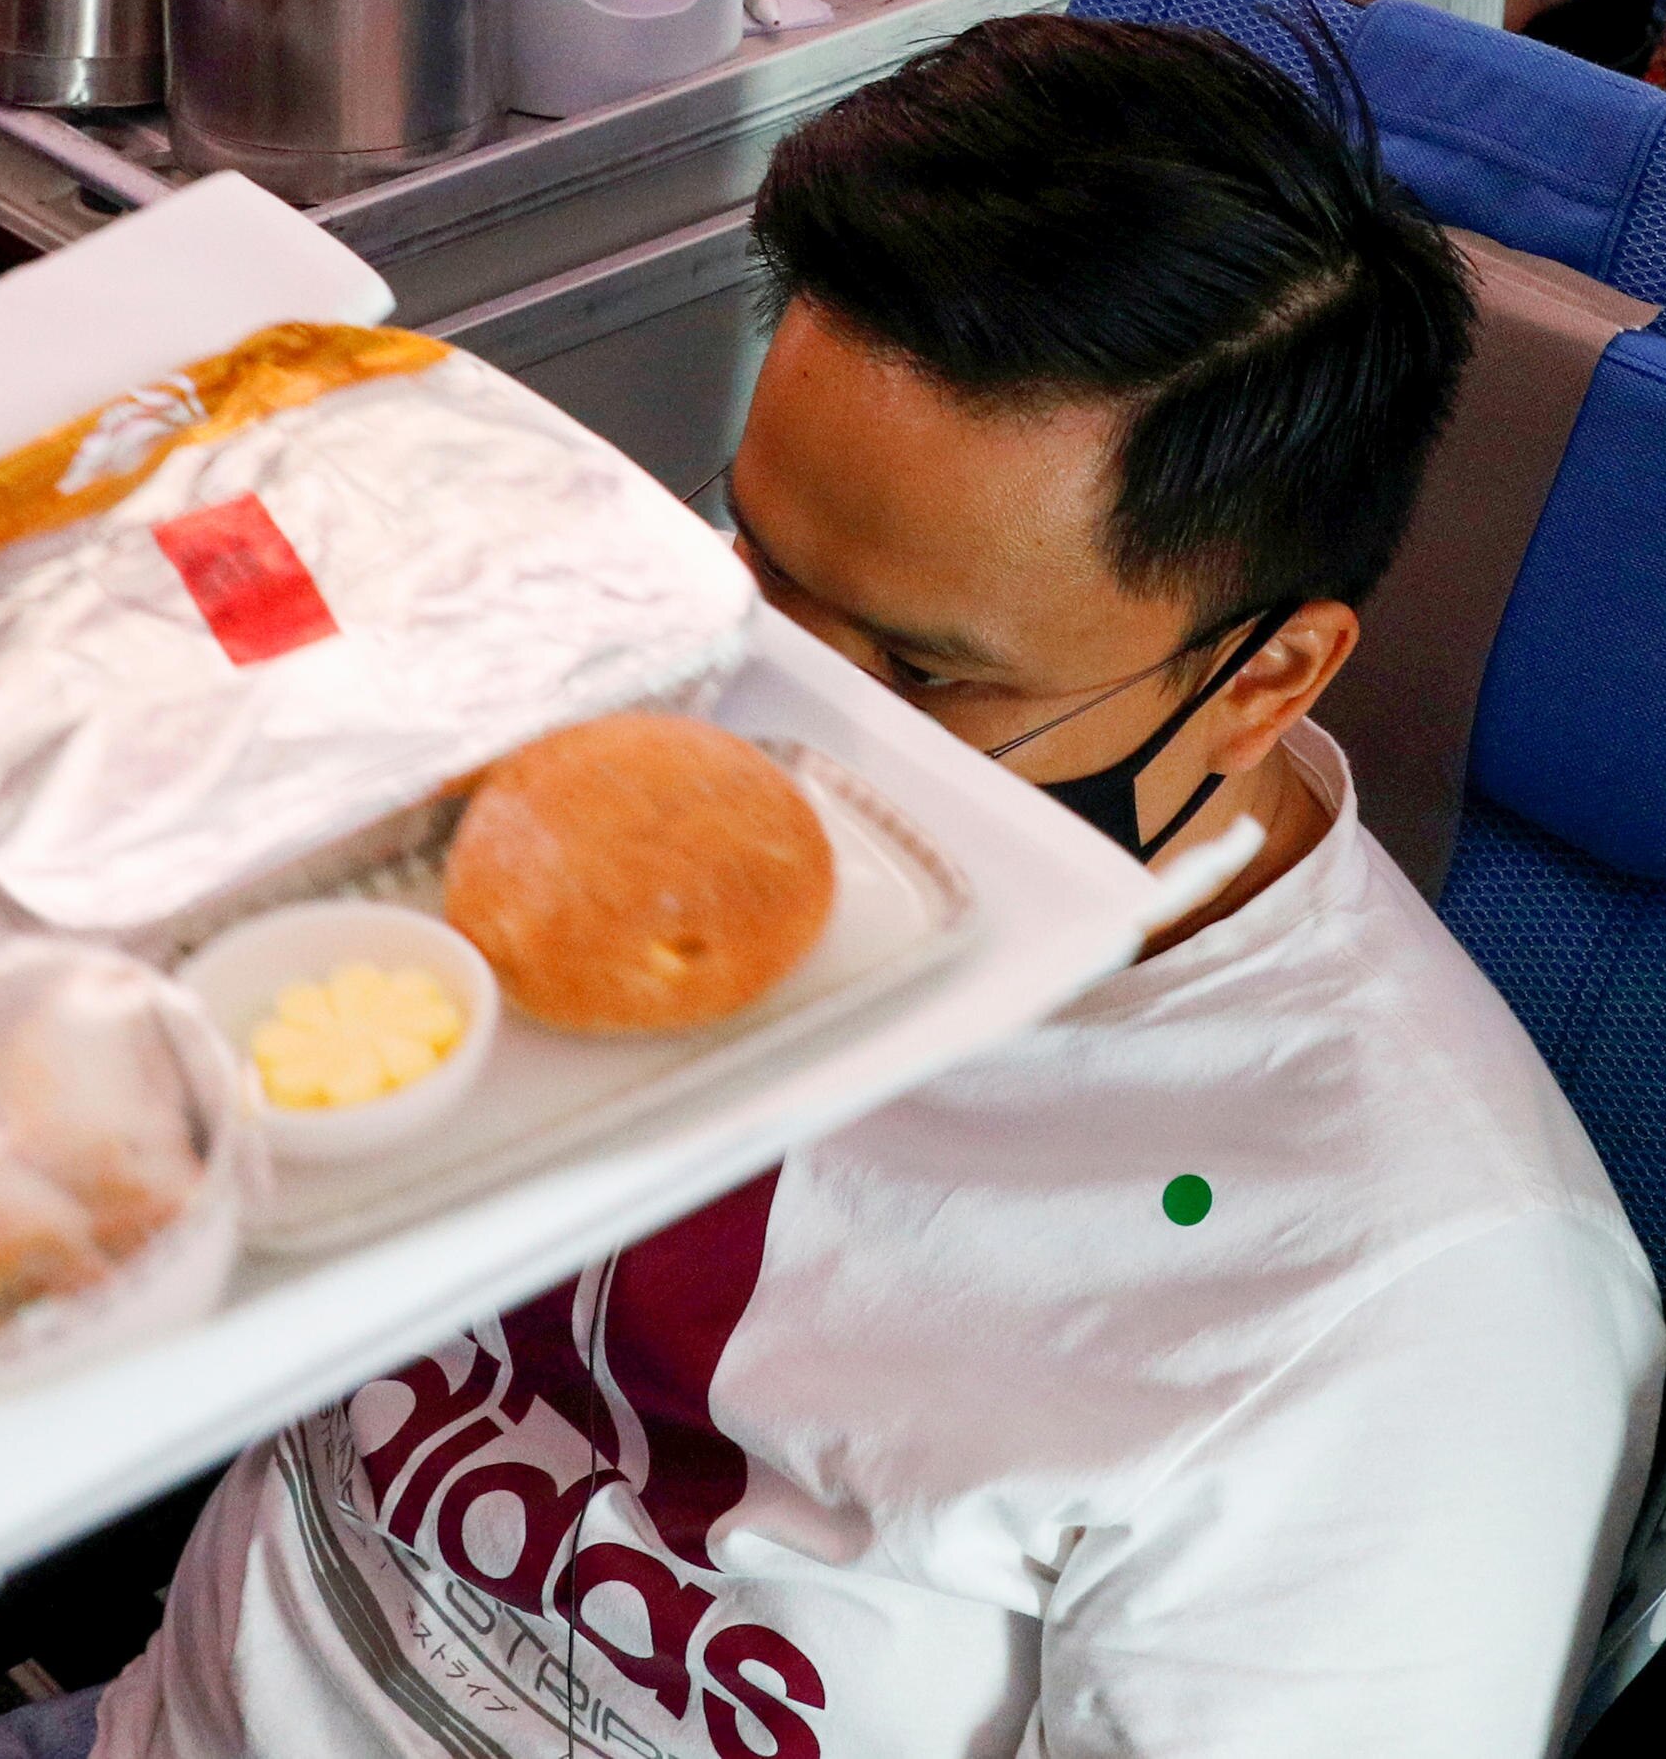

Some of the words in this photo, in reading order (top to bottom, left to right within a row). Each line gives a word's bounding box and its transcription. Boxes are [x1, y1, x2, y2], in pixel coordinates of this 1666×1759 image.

[343, 1332, 826, 1759] didas
[406, 1600, 518, 1716] ストライプ
